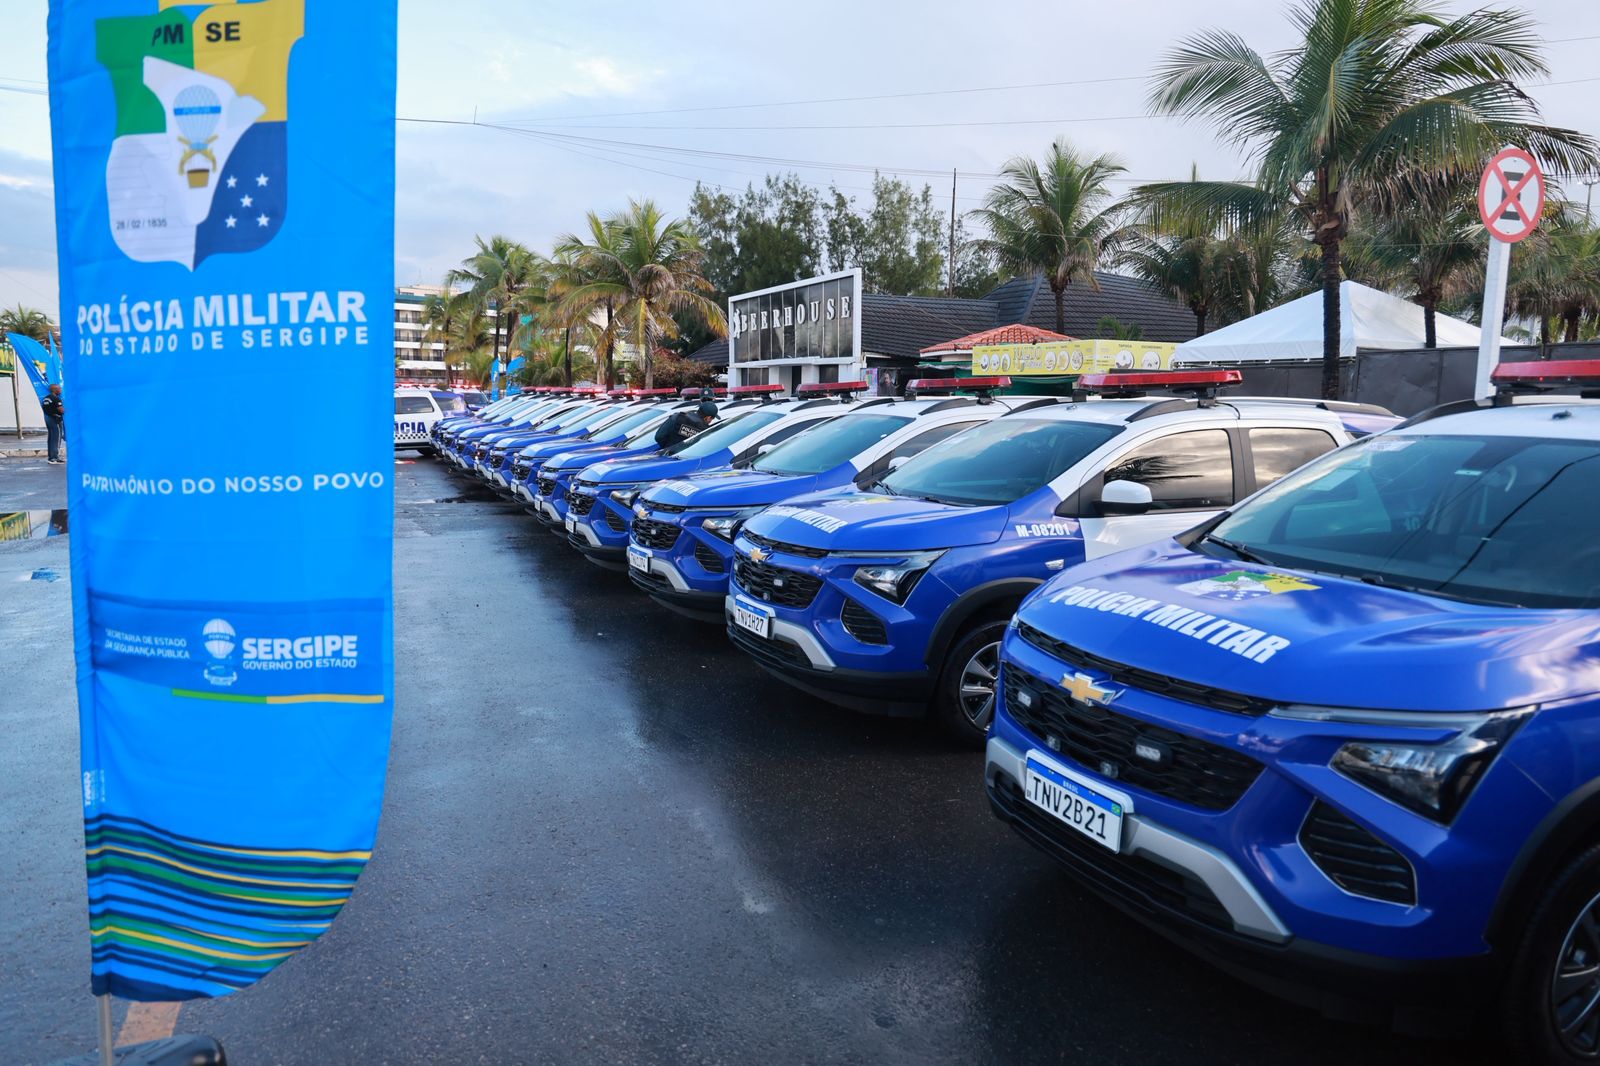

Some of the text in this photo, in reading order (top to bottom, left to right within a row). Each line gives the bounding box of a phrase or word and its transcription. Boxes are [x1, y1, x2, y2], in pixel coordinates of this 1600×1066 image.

[151, 21, 241, 47] PM SE
[77, 291, 368, 335] POLÍCIA MILITAR
[740, 295, 850, 332] BEERHOUSE
[101, 333, 178, 355] ESTADO
[192, 331, 223, 350] DE
[242, 326, 368, 348] SERGIPE
[82, 471, 384, 495] PATRIMÔNIO DO NOSSO POVO
[1015, 523, 1071, 537] M-08201
[737, 608, 764, 633] TNV1H27
[1051, 585, 1292, 664] POLÍCIA MILITAR
[113, 641, 156, 657] SEGURANÇA
[142, 635, 153, 645] DE
[154, 636, 187, 648] ESTADO
[242, 635, 358, 660] SERGIPE
[242, 657, 357, 671] GOVERNO DO ESTADO
[1033, 776, 1107, 840] TNV2B21
